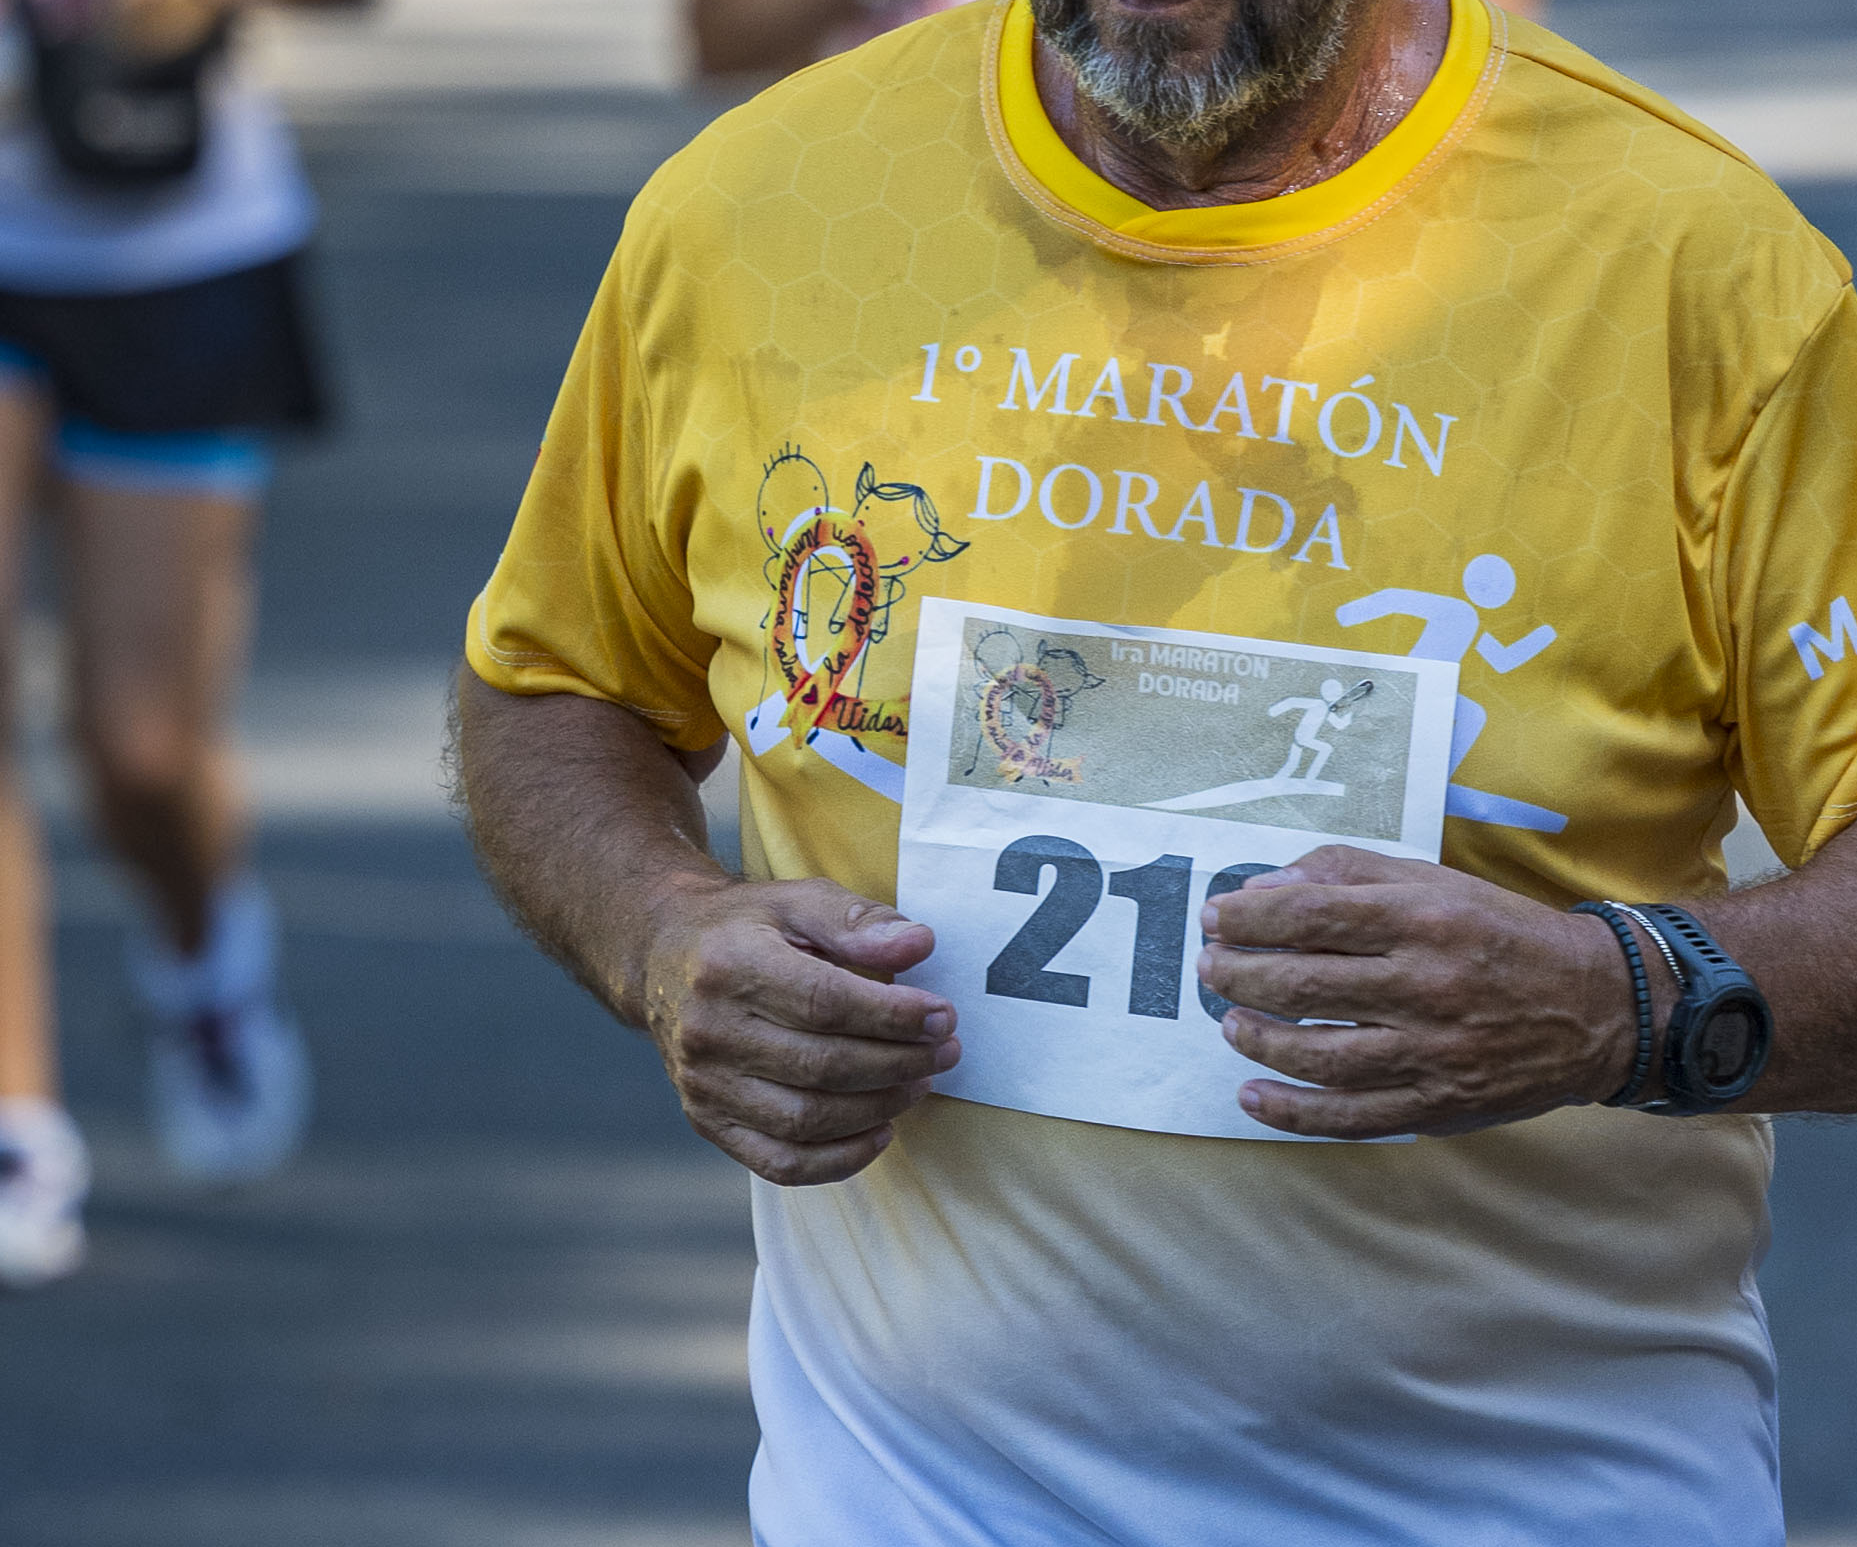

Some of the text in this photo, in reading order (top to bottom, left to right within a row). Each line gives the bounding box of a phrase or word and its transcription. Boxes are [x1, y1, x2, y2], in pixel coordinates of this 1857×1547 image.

[997, 347, 1459, 477] MARATÓN
[967, 455, 1352, 571] DORADA
[1138, 671, 1240, 705] DORADA
